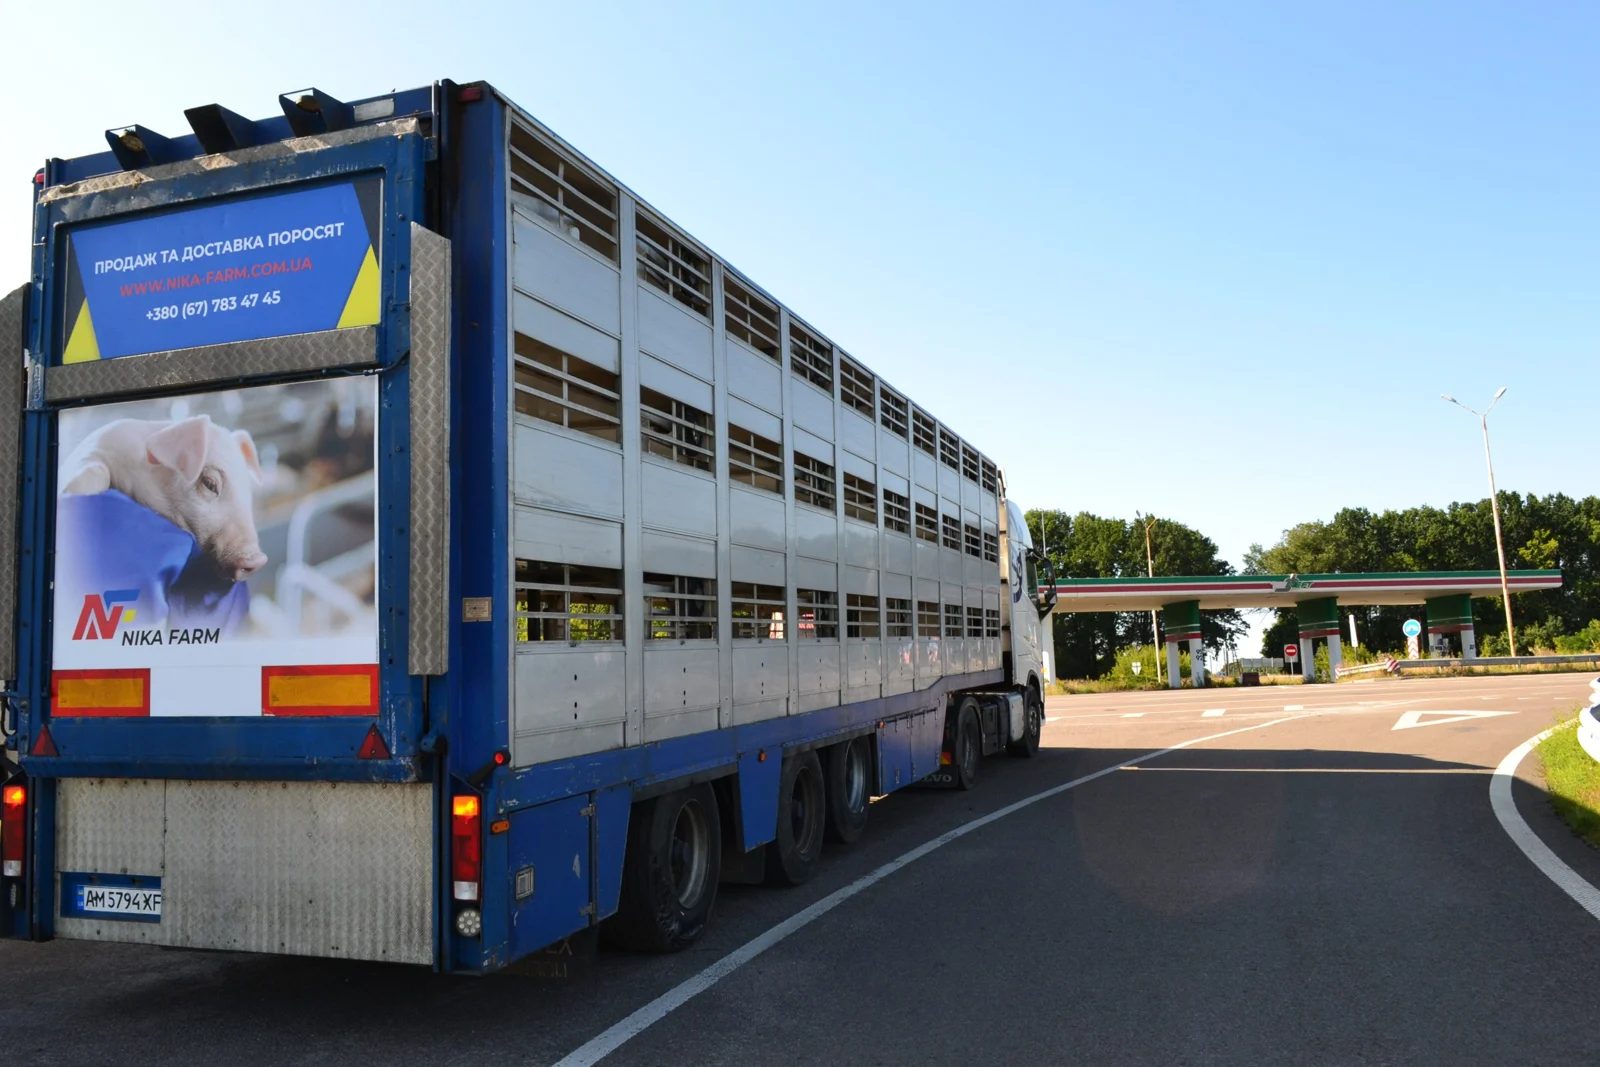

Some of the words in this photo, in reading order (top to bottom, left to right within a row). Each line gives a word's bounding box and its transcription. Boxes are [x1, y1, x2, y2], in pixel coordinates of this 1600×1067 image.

[94, 251, 158, 275] ПРОДАЖ
[160, 247, 179, 263] ТА
[181, 235, 265, 263] ДОСТАВКА
[267, 222, 346, 247] ПОРОСЯТ
[119, 257, 313, 298] WWW.NIKA-FARM.COM.UA
[145, 304, 179, 322] +380
[182, 298, 208, 319] (67)
[211, 296, 238, 314] 783
[240, 293, 259, 309] 47
[262, 290, 282, 306] 45
[121, 630, 164, 646] NIKA
[168, 627, 221, 645] FARM
[922, 774, 952, 782] LVO
[108, 892, 140, 910] 5794
